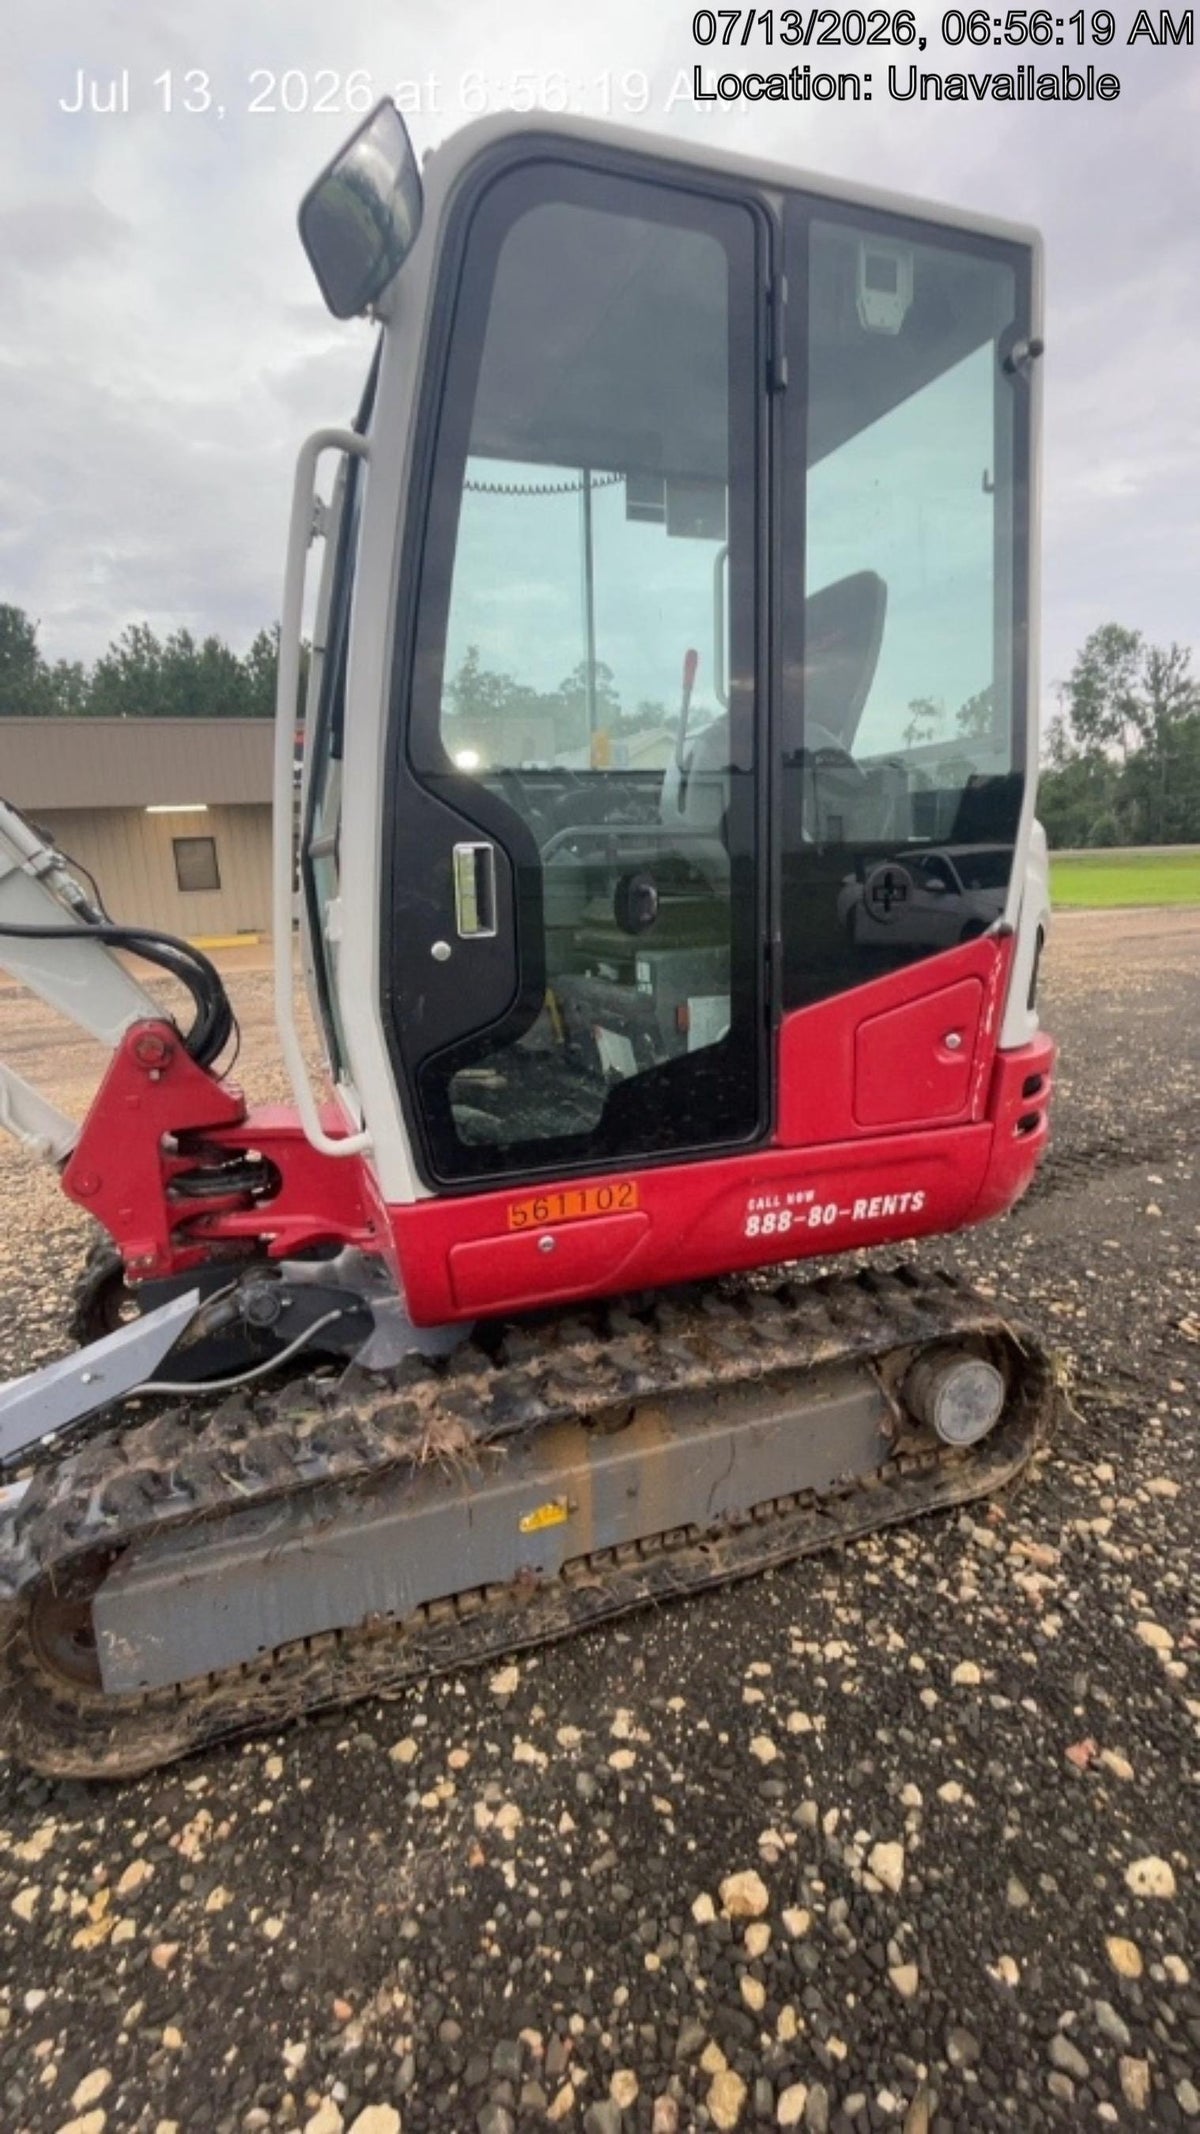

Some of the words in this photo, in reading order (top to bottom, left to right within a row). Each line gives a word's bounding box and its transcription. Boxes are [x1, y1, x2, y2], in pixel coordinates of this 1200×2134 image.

[511, 1183, 632, 1227] 561102
[744, 1190, 926, 1238] 888-80-RENTS
[748, 1195, 781, 1212] CALL
[786, 1190, 816, 1206] NOW
